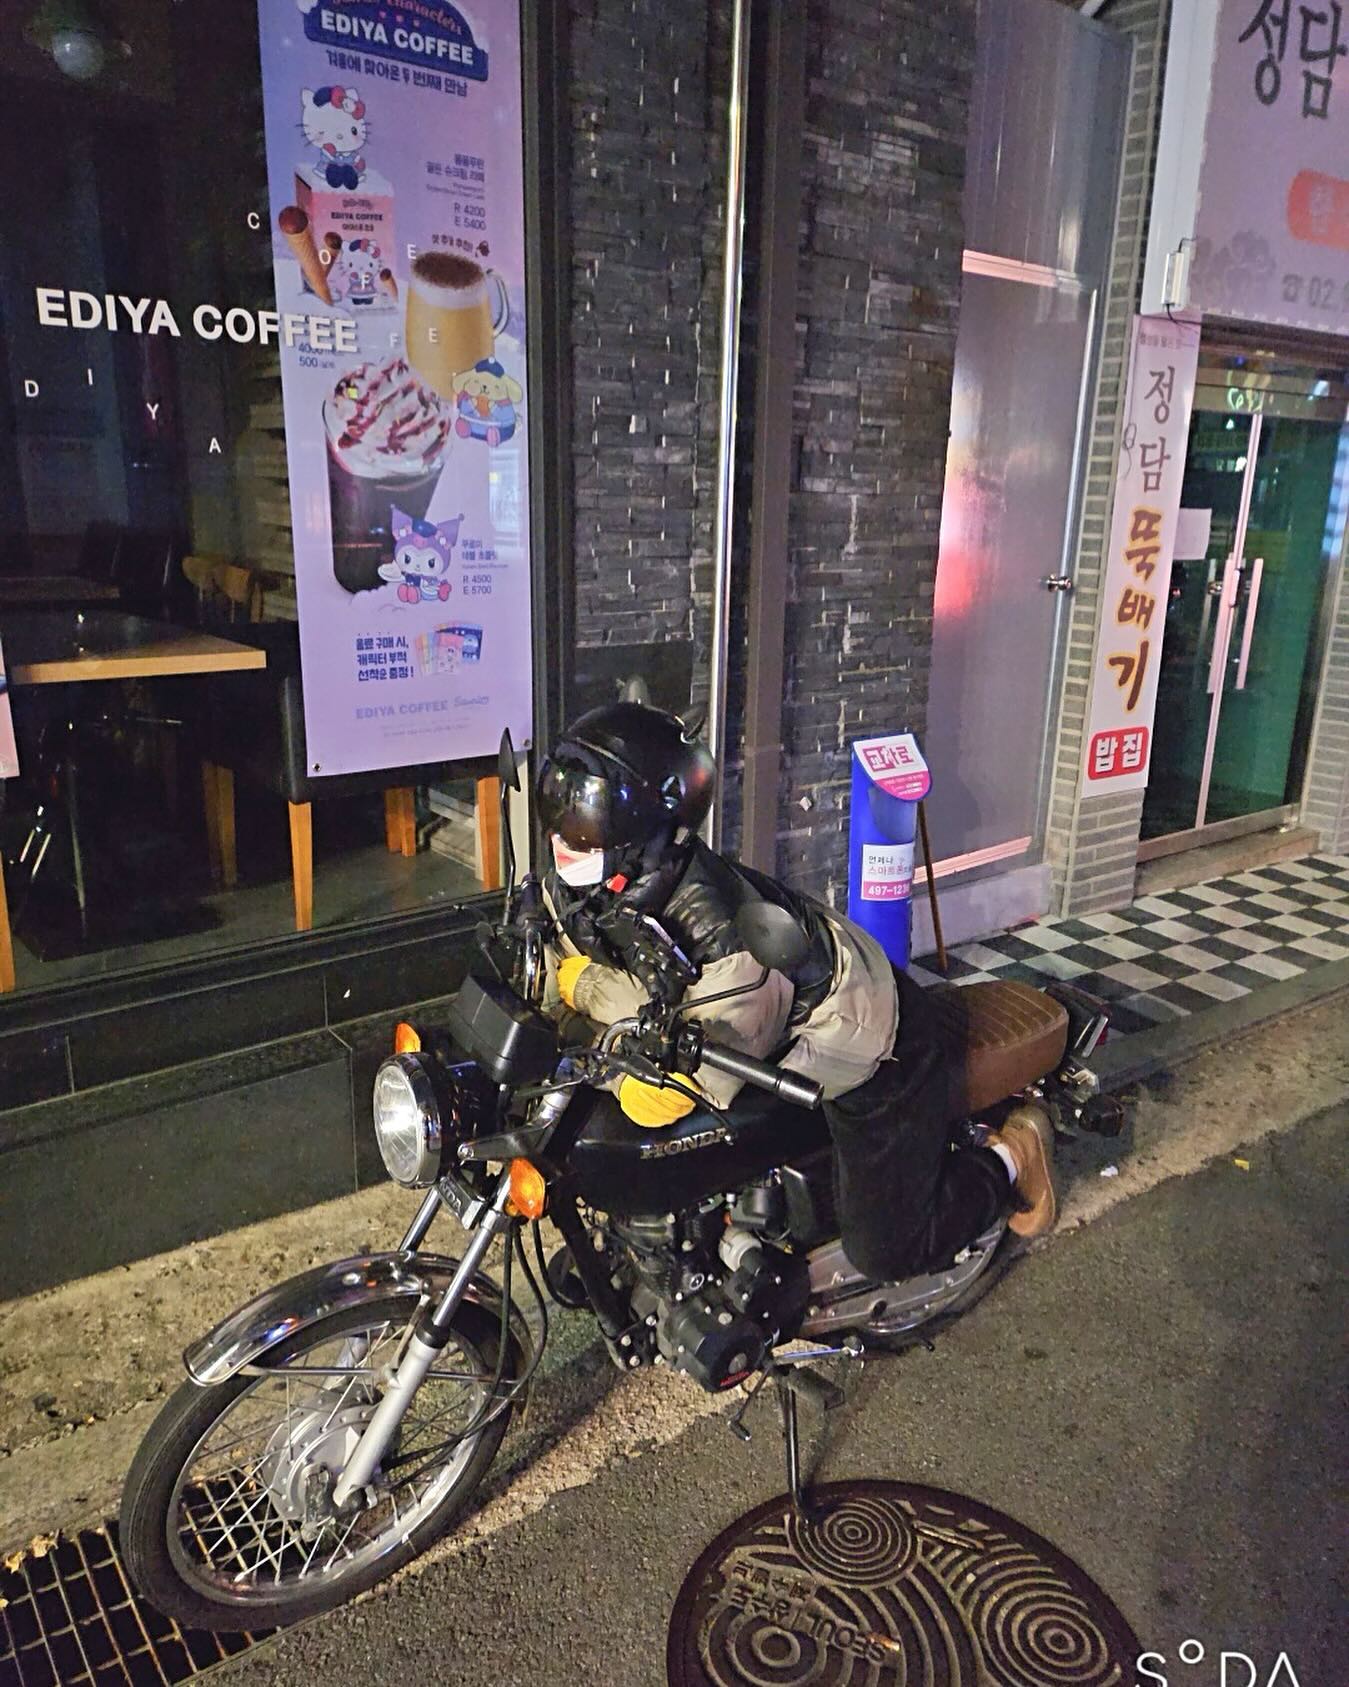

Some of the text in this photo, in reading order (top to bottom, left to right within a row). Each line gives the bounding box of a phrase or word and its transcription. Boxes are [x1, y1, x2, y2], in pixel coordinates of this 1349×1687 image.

[321, 10, 474, 65] EDIYA COFFEE
[364, 60, 400, 82] 찾아온
[412, 71, 442, 91] 번째
[444, 78, 468, 98] 만남
[454, 202, 486, 217] R 4200
[248, 212, 261, 230] C
[454, 216, 487, 231] E 5400
[36, 287, 360, 353] EDIYA COFFEE
[298, 356, 318, 368] 500
[24, 380, 40, 398] D
[146, 402, 160, 421] Y
[208, 437, 223, 454] A
[1139, 365, 1178, 493] 정담
[472, 574, 492, 584] 4500
[463, 585, 492, 595] E 5700
[1108, 508, 1163, 713] 뚝배기
[356, 636, 410, 651] 음료 구매 시,
[357, 651, 408, 666] 캐릭터 부적
[358, 668, 388, 682] 선착순
[356, 706, 395, 719] EDIYA
[399, 701, 448, 715] COFFEE
[1093, 730, 1145, 773] 밥집
[640, 1128, 733, 1160] HONDA
[812, 1611, 887, 1663] SEOUL
